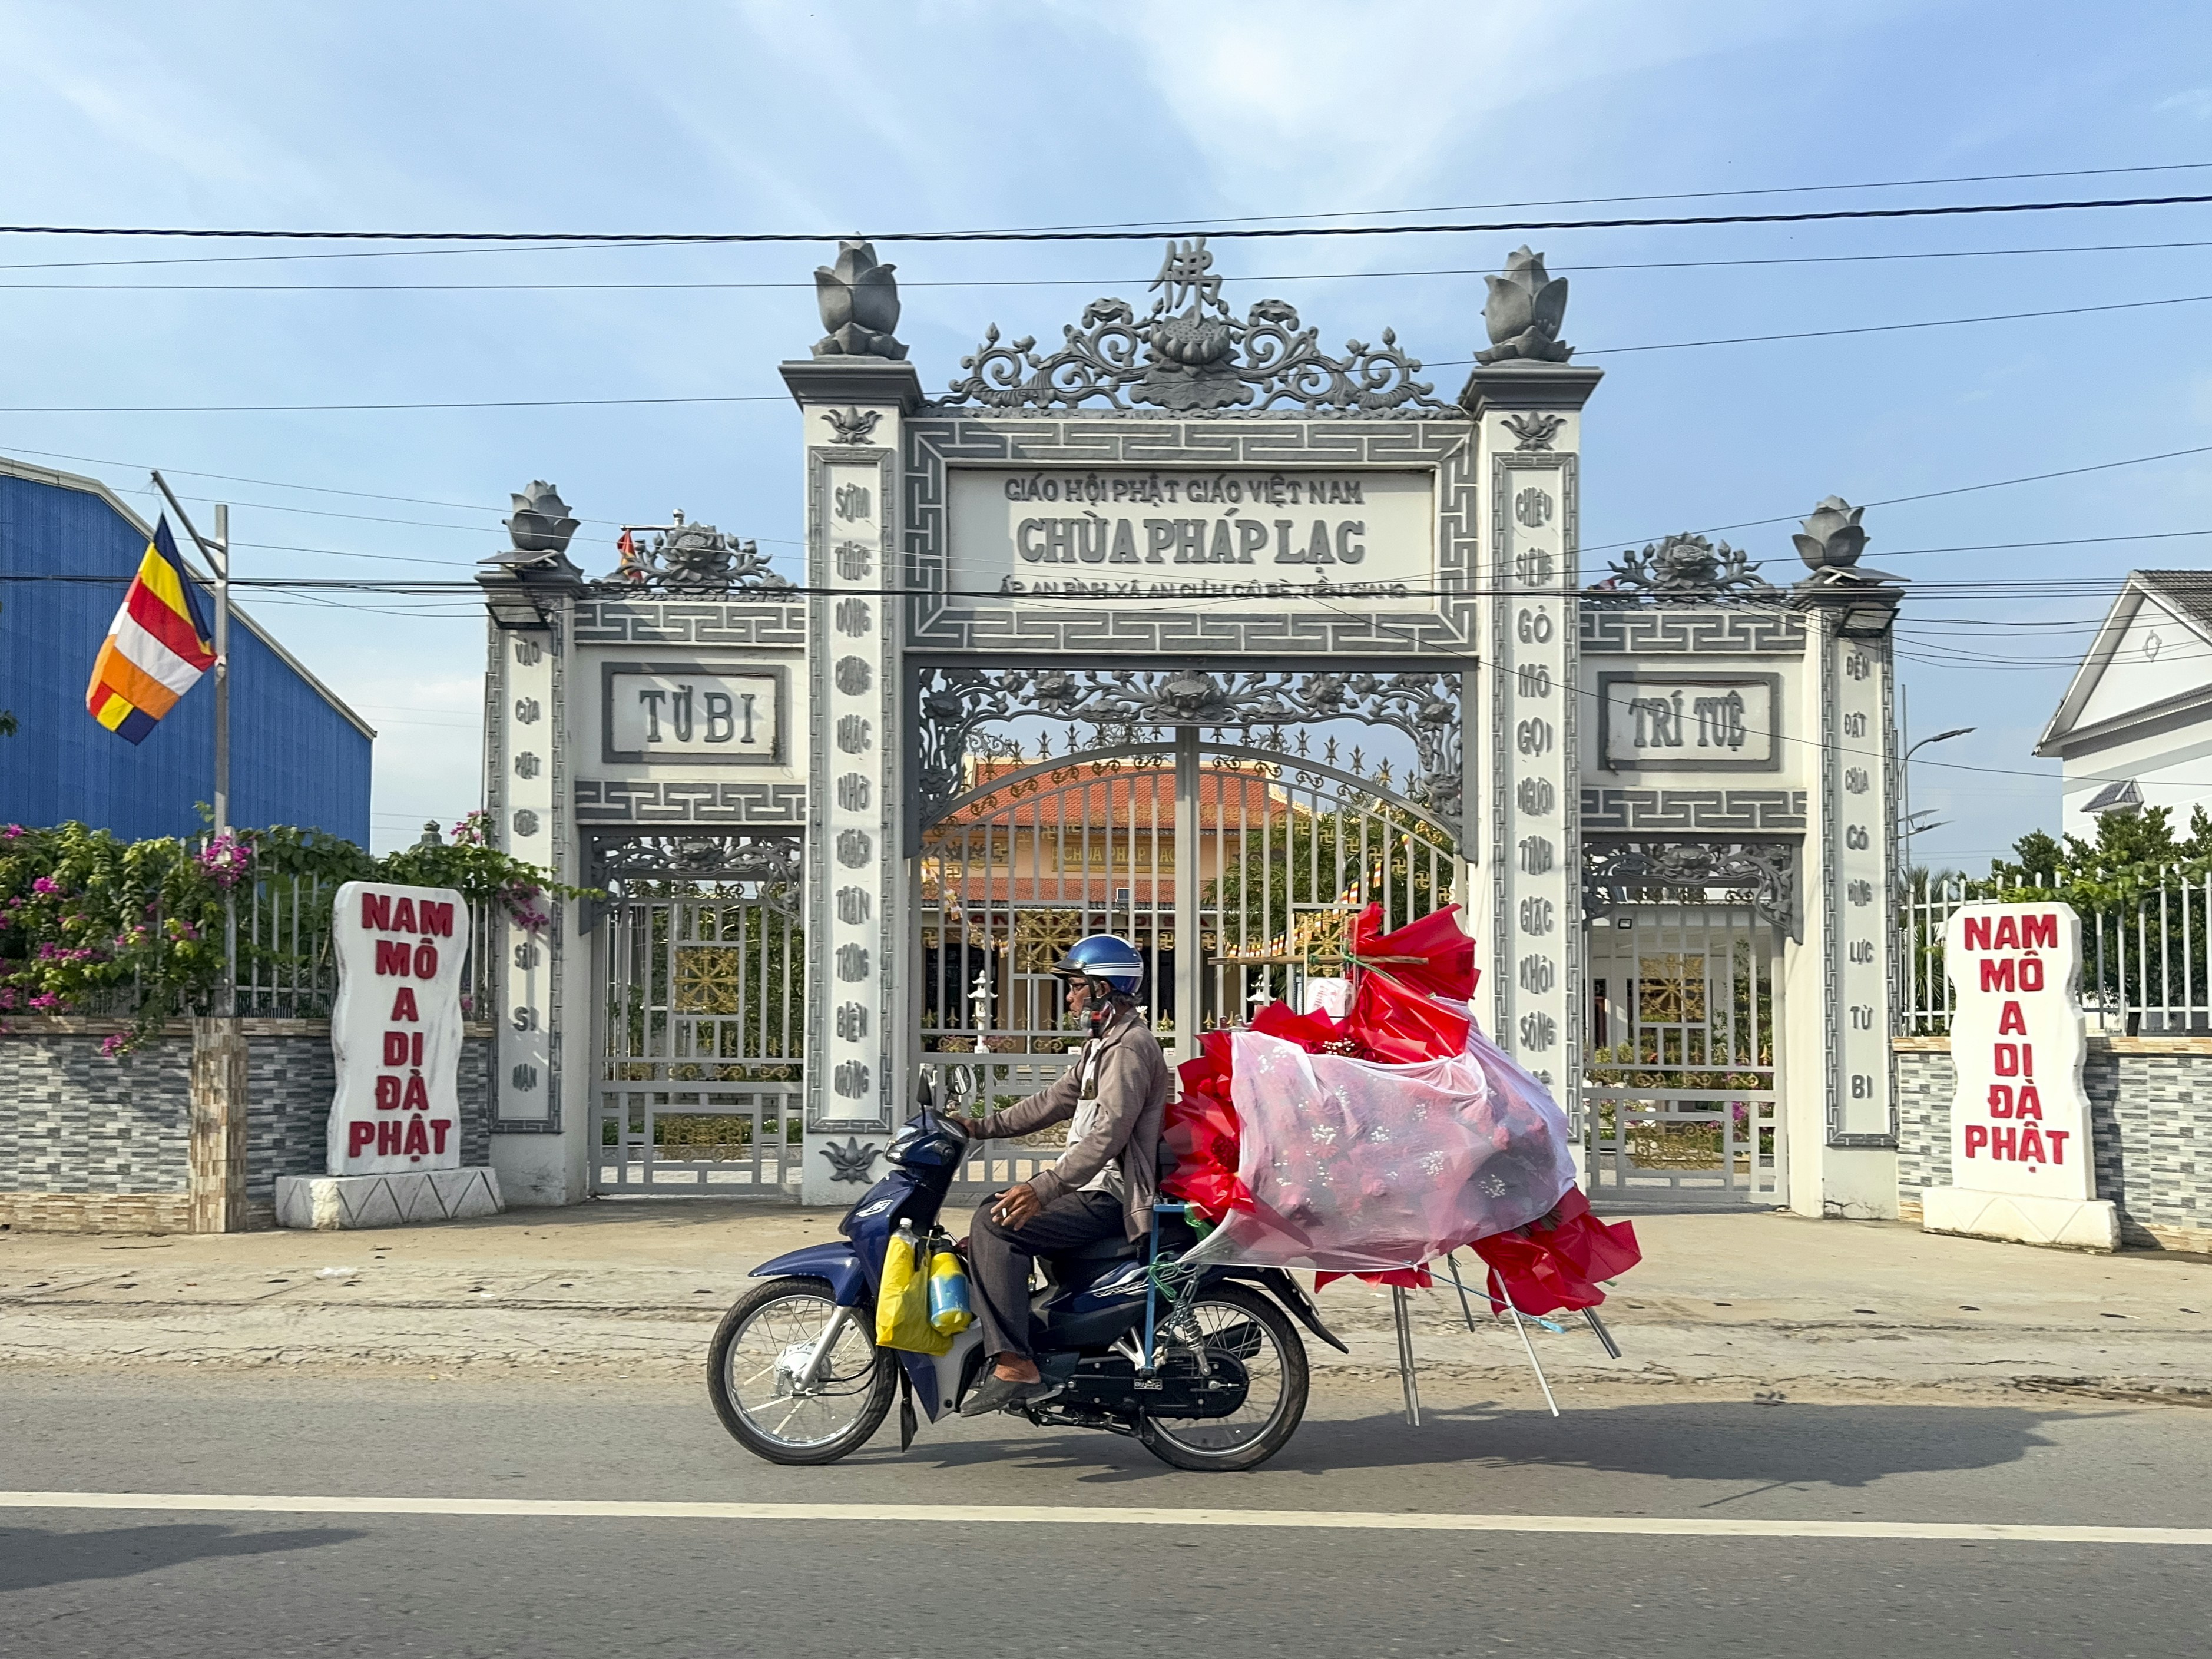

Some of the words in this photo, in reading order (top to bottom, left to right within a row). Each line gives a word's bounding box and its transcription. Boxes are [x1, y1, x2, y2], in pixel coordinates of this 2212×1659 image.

[1005, 472, 1058, 501] GIÁO
[1065, 472, 1112, 506] HỘI
[1112, 472, 1180, 508] PHẬT
[1186, 473, 1244, 504] GIÁO
[1247, 473, 1302, 508] VIỆT
[1309, 481, 1365, 504] NAM
[1017, 510, 1143, 564] CHÙA
[1143, 507, 1269, 564] PHÁP
[1274, 519, 1366, 574] LẠC
[639, 684, 693, 742] TỪ
[704, 692, 756, 743] BI
[1628, 690, 1684, 747] TRÍ
[1694, 690, 1746, 752] TUỆ
[1518, 717, 1553, 757] GỌI
[362, 892, 454, 938] NAM
[1519, 896, 1554, 937] GIẤC
[1963, 914, 2058, 950] NAM
[375, 938, 438, 979] MÔ
[1850, 938, 1874, 965] LỰC
[1979, 950, 2044, 992] MÔ
[1520, 953, 1555, 994] KHỎI
[391, 987, 419, 1022] A
[512, 1006, 539, 1032] SI
[1850, 1004, 1874, 1030] TỪ
[1999, 1001, 2027, 1035] A
[383, 1031, 424, 1067] DI
[1520, 1011, 1557, 1052] SÔNG
[1994, 1043, 2033, 1077] DI
[375, 1069, 429, 1110] ĐÀ
[1852, 1075, 1873, 1100] BI
[1988, 1079, 2043, 1120] ĐÀ
[348, 1112, 451, 1162] PHẬT
[1965, 1121, 2069, 1173] PHẬT
